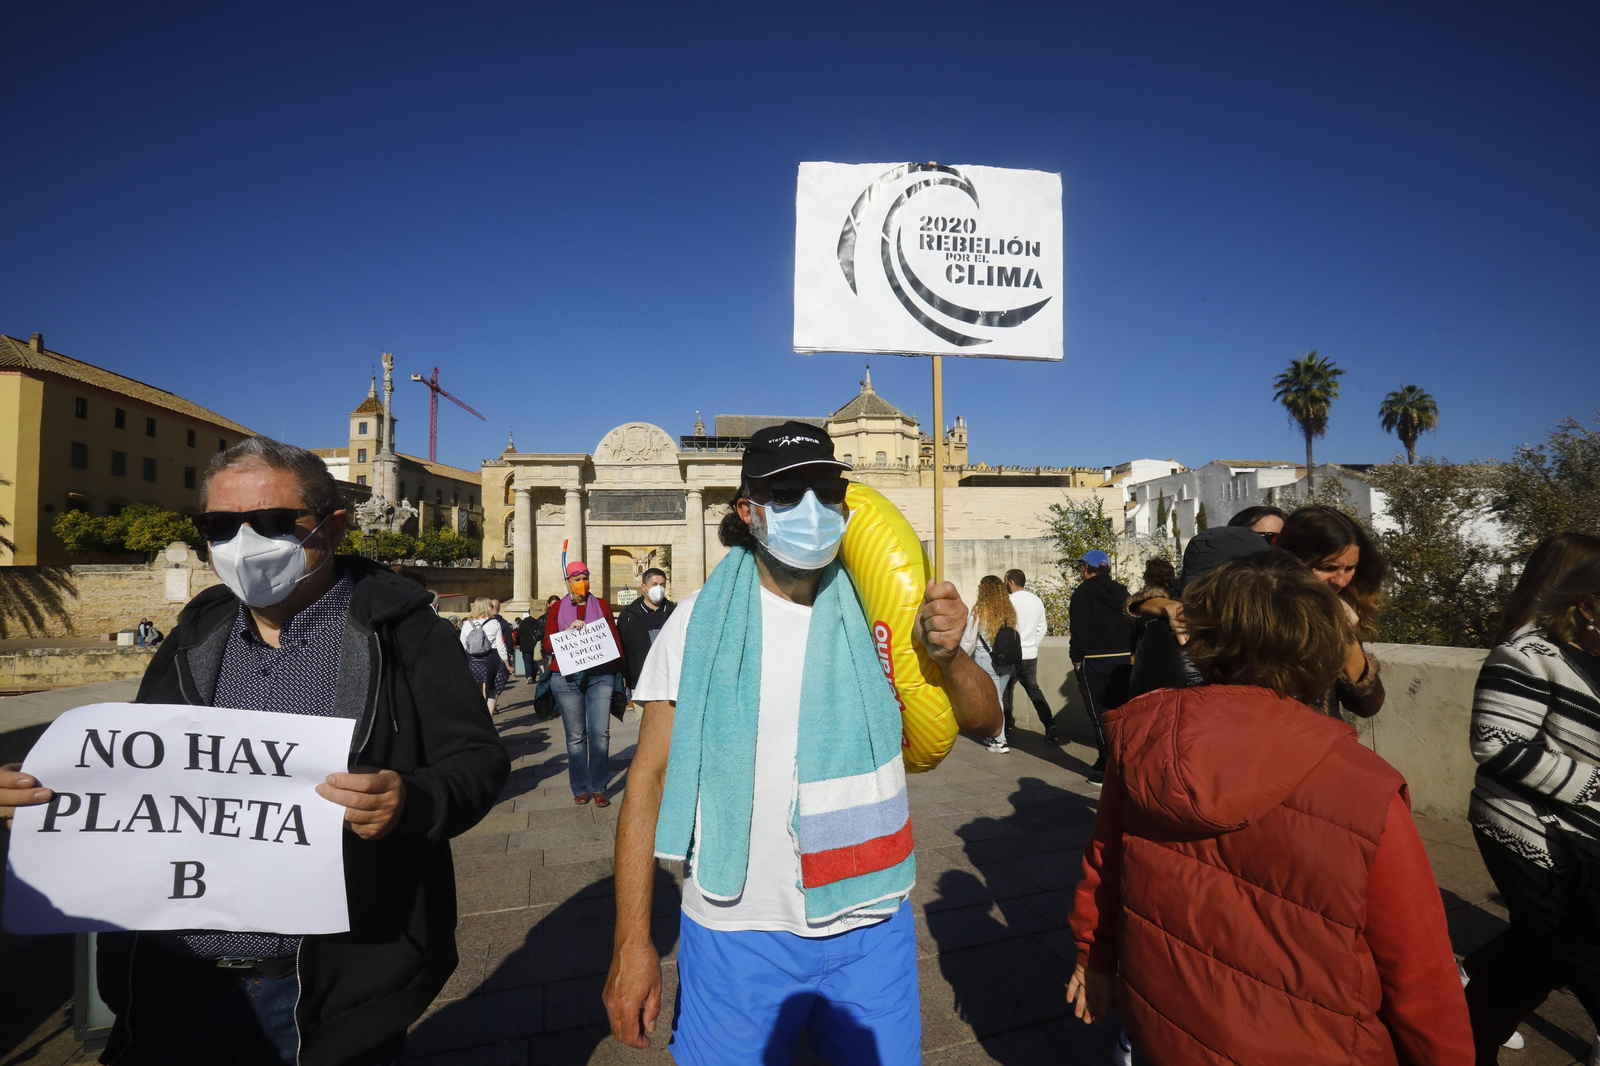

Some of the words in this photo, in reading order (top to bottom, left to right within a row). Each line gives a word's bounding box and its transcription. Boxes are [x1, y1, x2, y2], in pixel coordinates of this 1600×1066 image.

[919, 215, 977, 234] 2020
[919, 234, 1041, 257] REBELIÓN
[945, 253, 971, 262] POR
[975, 254, 989, 263] EL
[945, 263, 1043, 289] CLIMA
[554, 635, 564, 645] NI
[564, 631, 577, 641] UN
[578, 623, 606, 636] GRADO
[560, 640, 579, 653] MÁS
[579, 638, 589, 646] NI
[589, 631, 607, 643] UNA
[569, 642, 604, 659] ESPECIE
[574, 652, 605, 667] MENOS
[75, 728, 165, 769] NO
[184, 732, 299, 778] HAY
[37, 792, 311, 846] PLANETA
[167, 860, 206, 899] B
